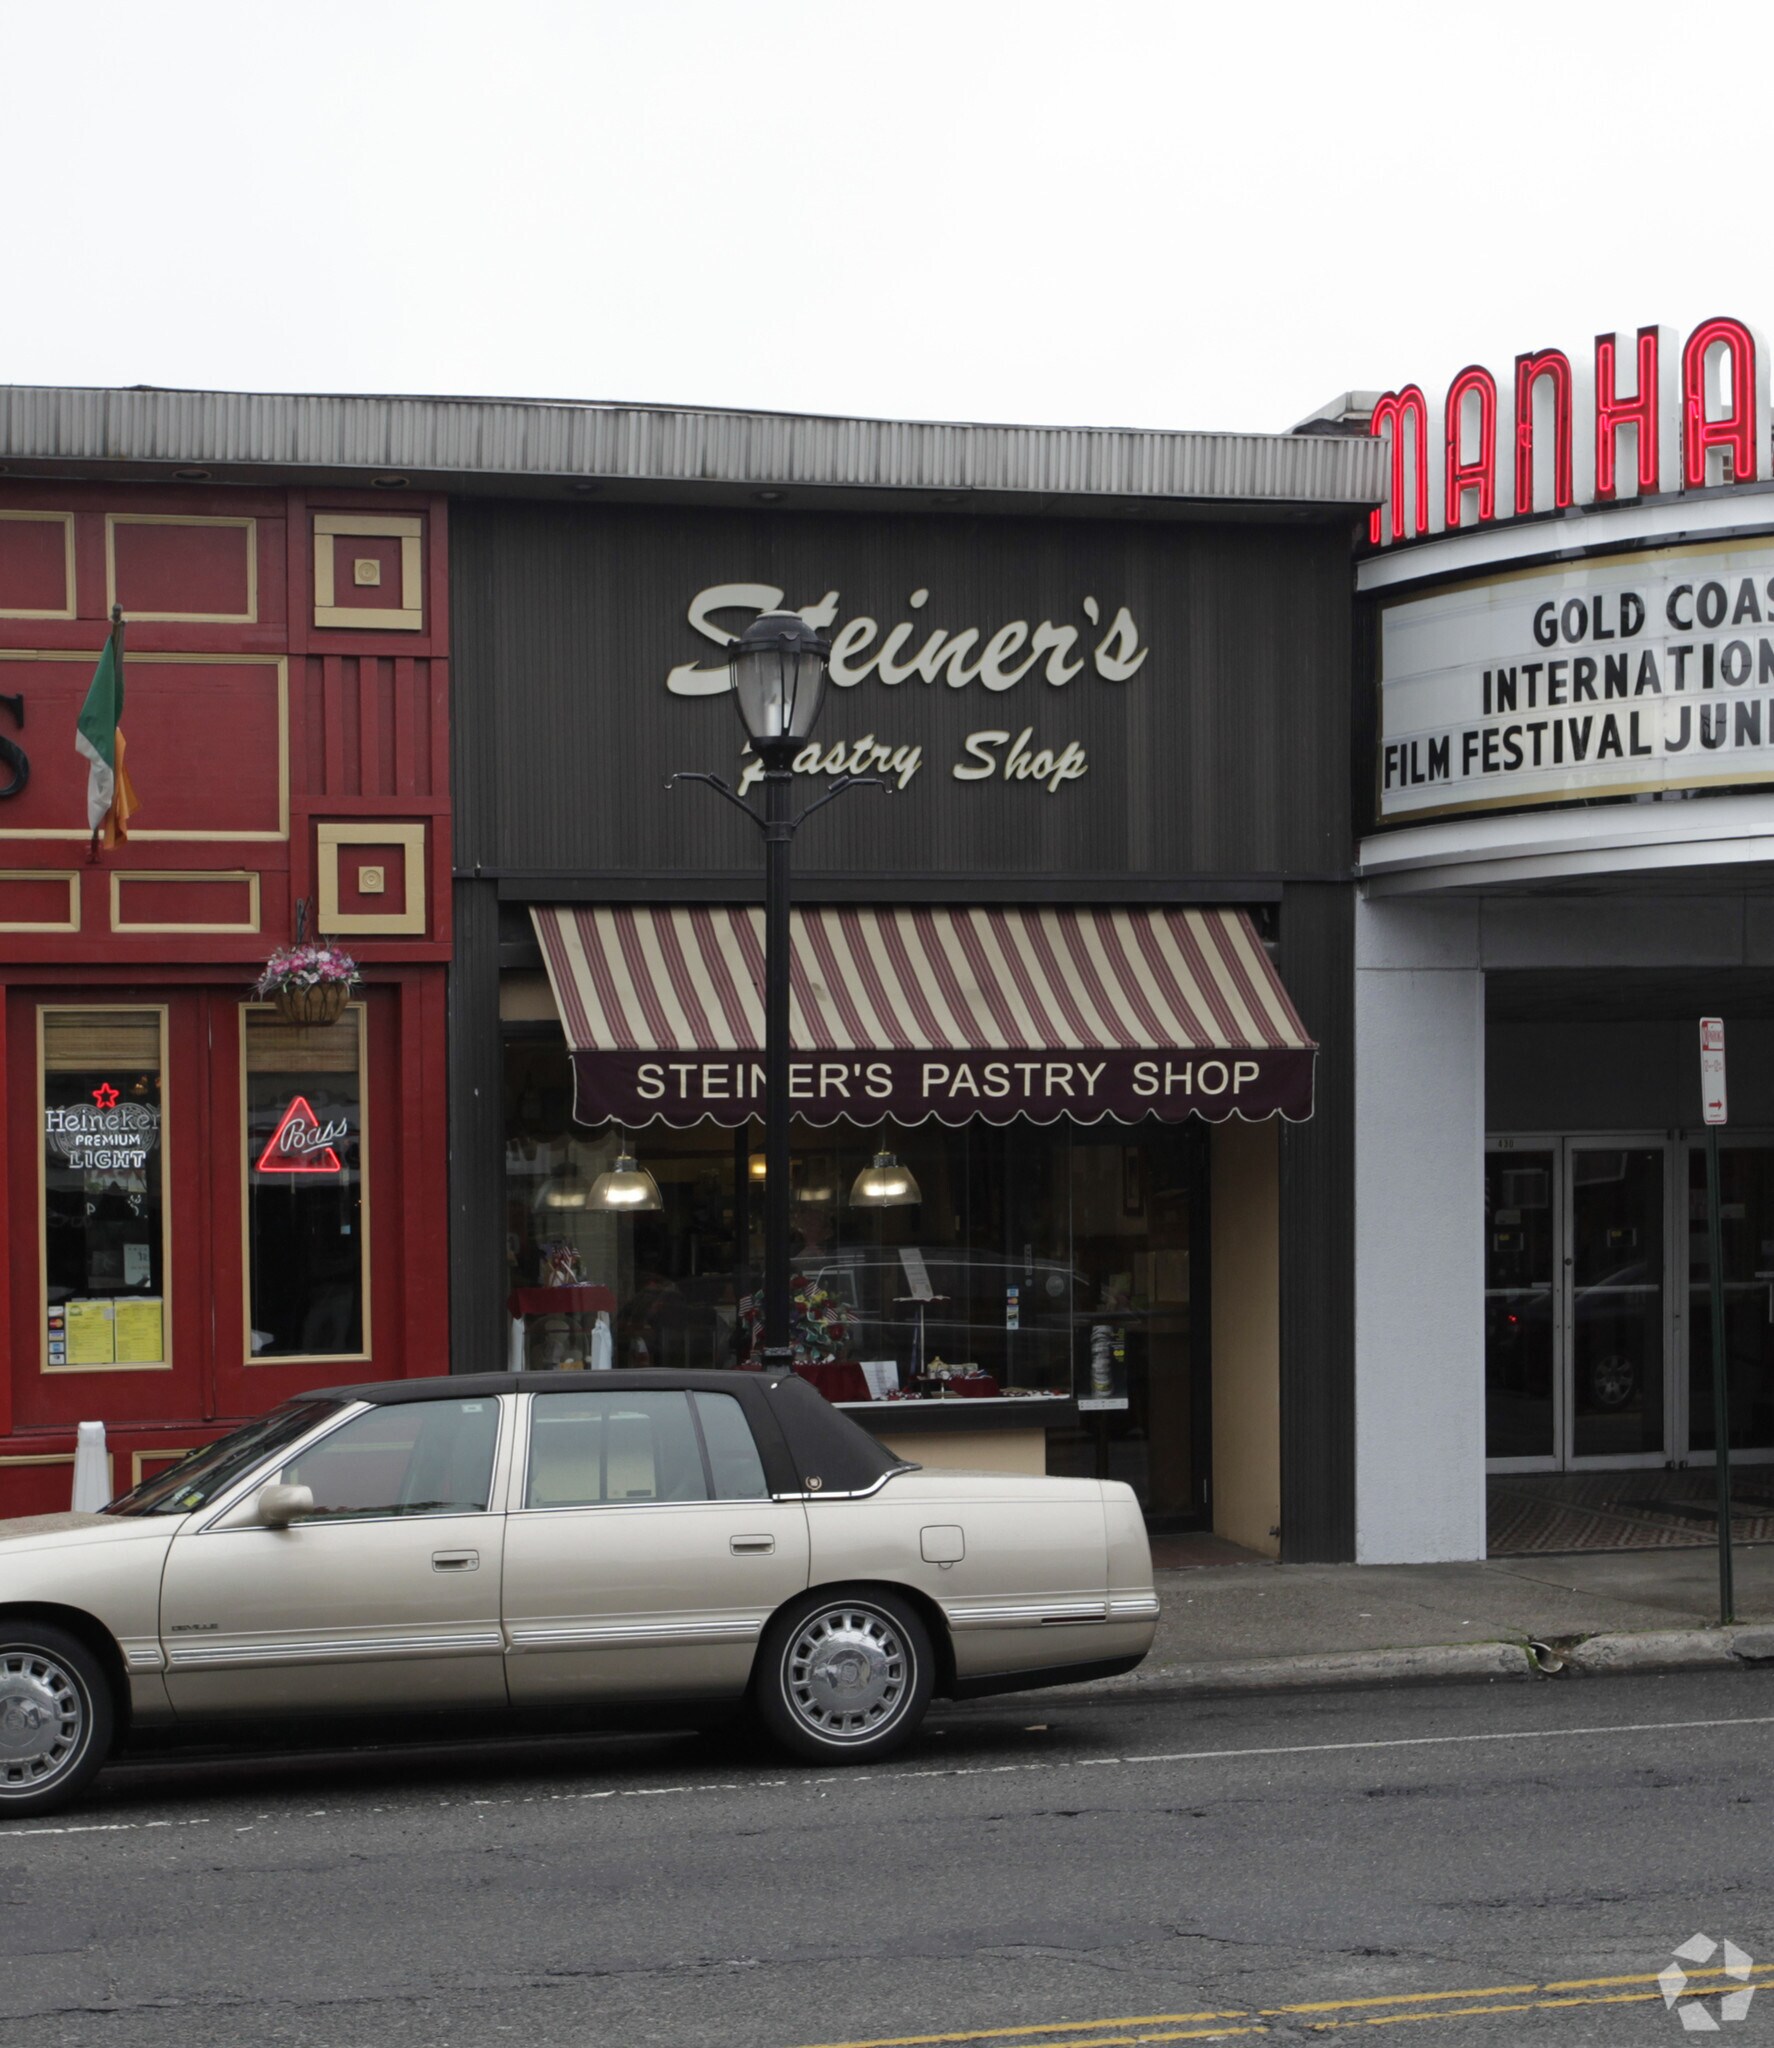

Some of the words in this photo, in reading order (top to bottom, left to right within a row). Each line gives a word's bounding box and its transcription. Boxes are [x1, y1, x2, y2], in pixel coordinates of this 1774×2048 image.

[1533, 592, 1645, 648] GOLD
[1665, 576, 1774, 632] COA
[953, 727, 1088, 793] Shop
[1384, 735, 1450, 789] FILM
[1462, 711, 1652, 776] FESTIVAL
[1664, 699, 1774, 752] JUN
[922, 1062, 1107, 1097] PASTRY
[1132, 1061, 1260, 1096] SHOP
[75, 1134, 141, 1146] PREMIUM
[280, 1117, 348, 1152] Bass
[69, 1150, 147, 1169] LIGHT
